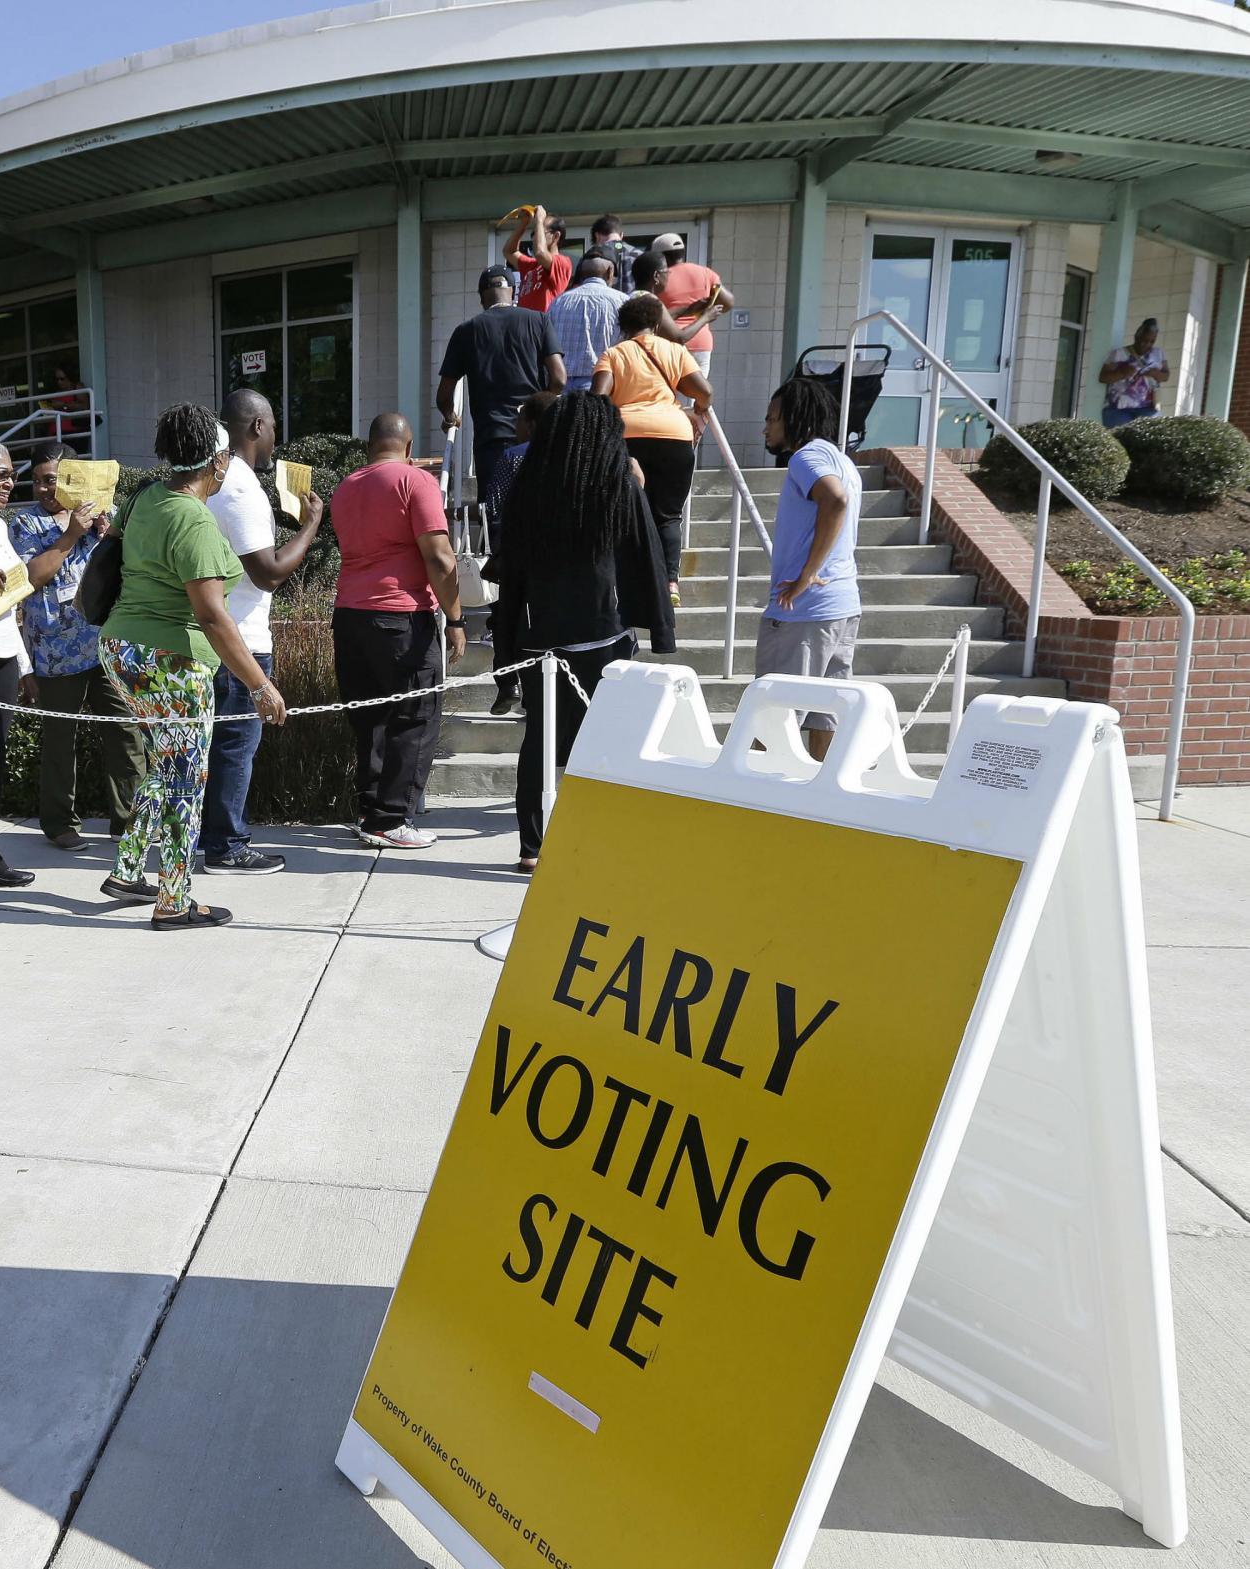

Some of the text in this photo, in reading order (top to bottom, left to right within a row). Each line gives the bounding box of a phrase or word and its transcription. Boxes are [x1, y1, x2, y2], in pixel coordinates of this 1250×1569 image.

[964, 247, 993, 267] 505
[243, 353, 264, 362] VOTE
[551, 916, 839, 1096] EARLY
[489, 1025, 832, 1281] VOTING
[501, 1192, 678, 1369] SITE
[372, 1384, 410, 1427] Property
[411, 1422, 423, 1437] of
[423, 1430, 448, 1462] Wake
[450, 1457, 487, 1499] County
[488, 1492, 523, 1532] Board
[523, 1528, 538, 1544] of
